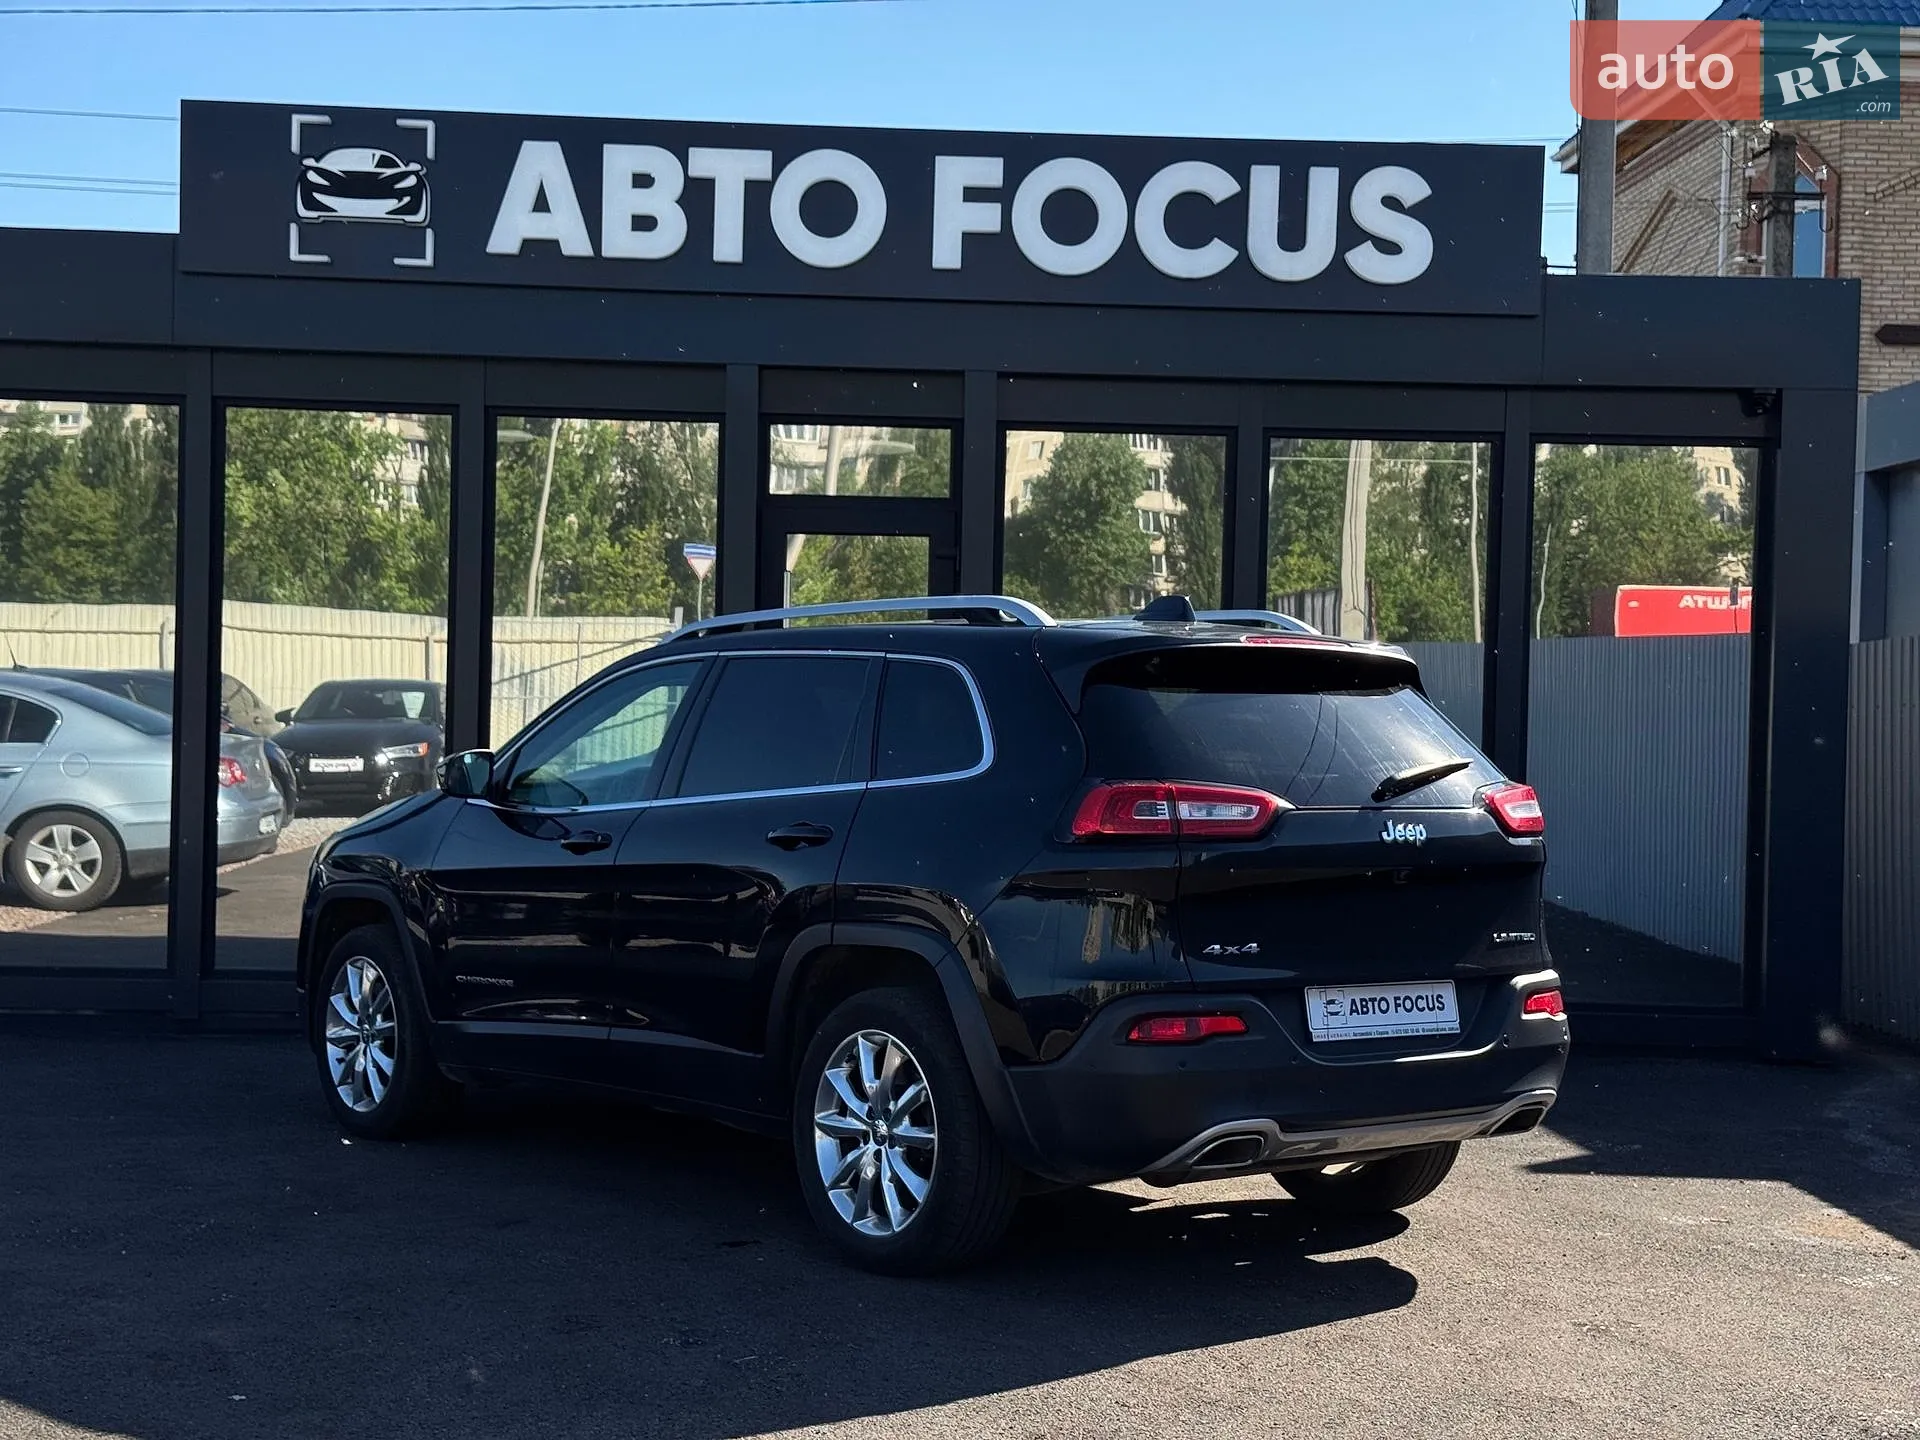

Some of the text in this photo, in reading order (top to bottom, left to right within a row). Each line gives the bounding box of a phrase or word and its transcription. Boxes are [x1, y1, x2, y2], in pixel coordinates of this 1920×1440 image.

[486, 140, 1434, 285] АВТО FOCUS
[1381, 819, 1427, 847] Jeep
[1202, 943, 1260, 955] 4x4
[1349, 993, 1445, 1016] АВТО FOCUS
